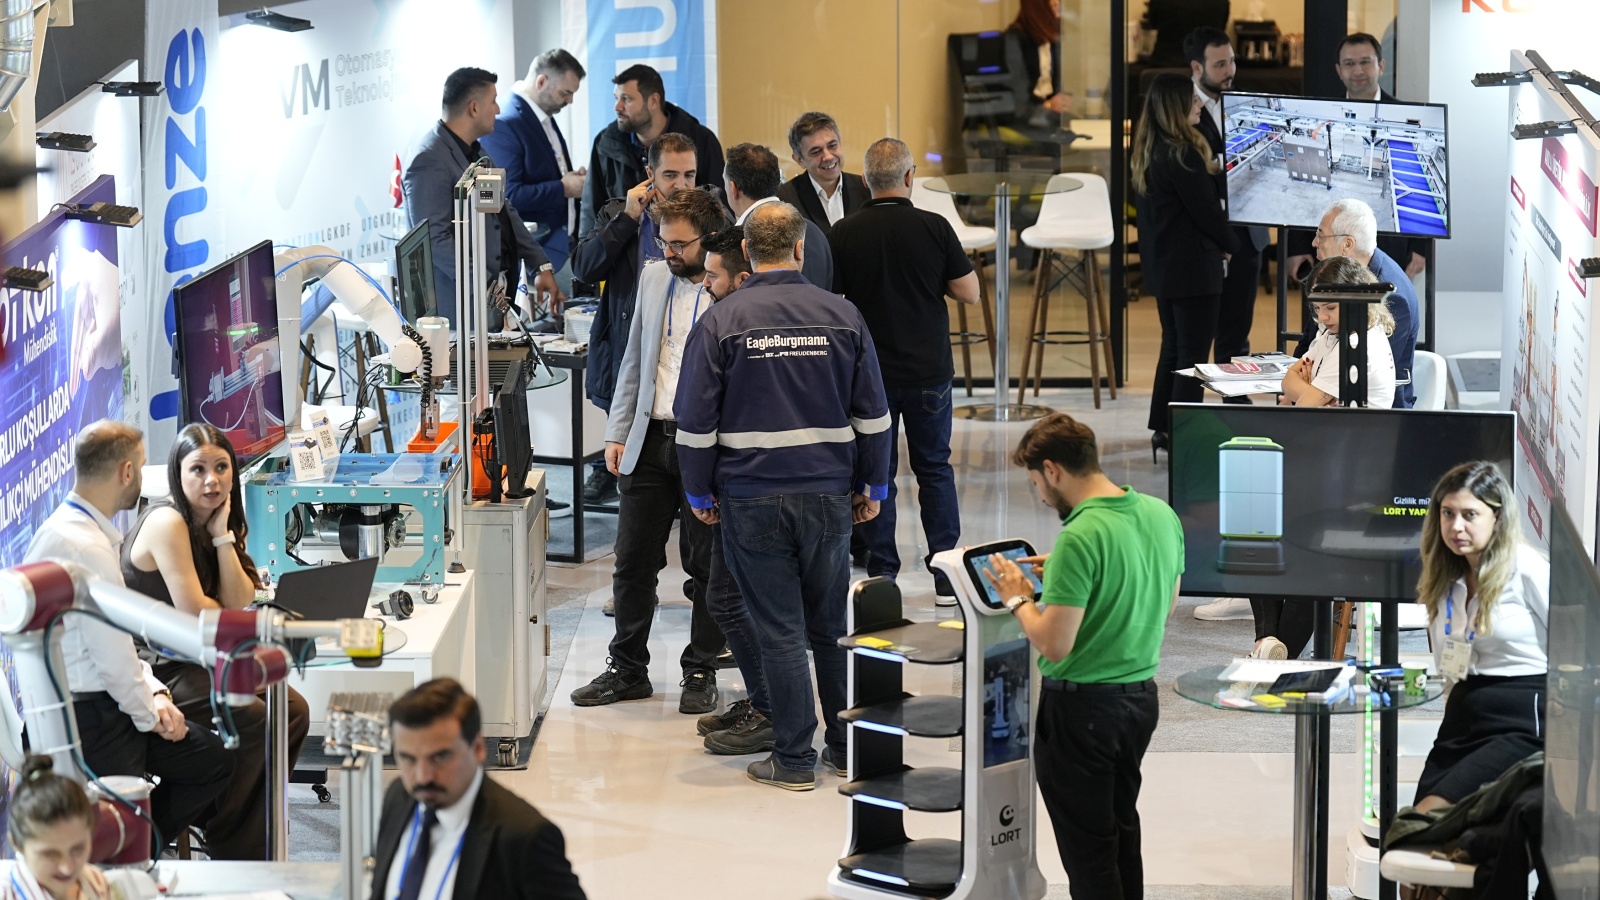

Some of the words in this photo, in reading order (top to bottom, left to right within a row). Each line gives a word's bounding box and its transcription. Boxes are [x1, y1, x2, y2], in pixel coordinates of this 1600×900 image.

[149, 27, 209, 420] nze
[16, 381, 70, 451] KOŞULLARDA
[1383, 507, 1407, 515] LORT
[991, 827, 1022, 846] LORT
